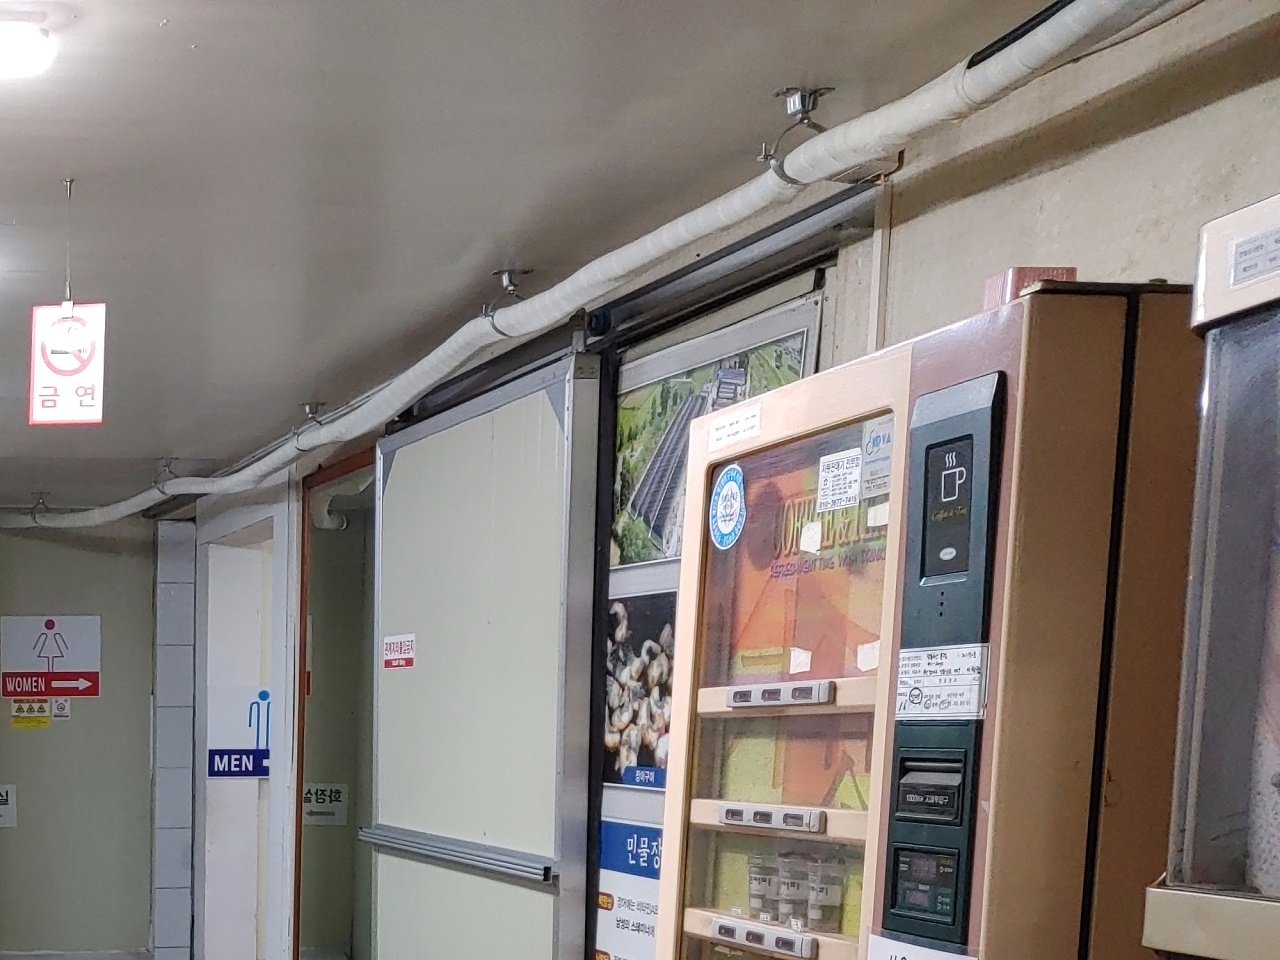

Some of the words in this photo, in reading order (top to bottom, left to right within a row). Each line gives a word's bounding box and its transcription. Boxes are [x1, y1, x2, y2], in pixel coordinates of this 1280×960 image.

[5, 676, 46, 692] WOMEN
[213, 754, 254, 772] MEN
[635, 769, 655, 784] 장어구이
